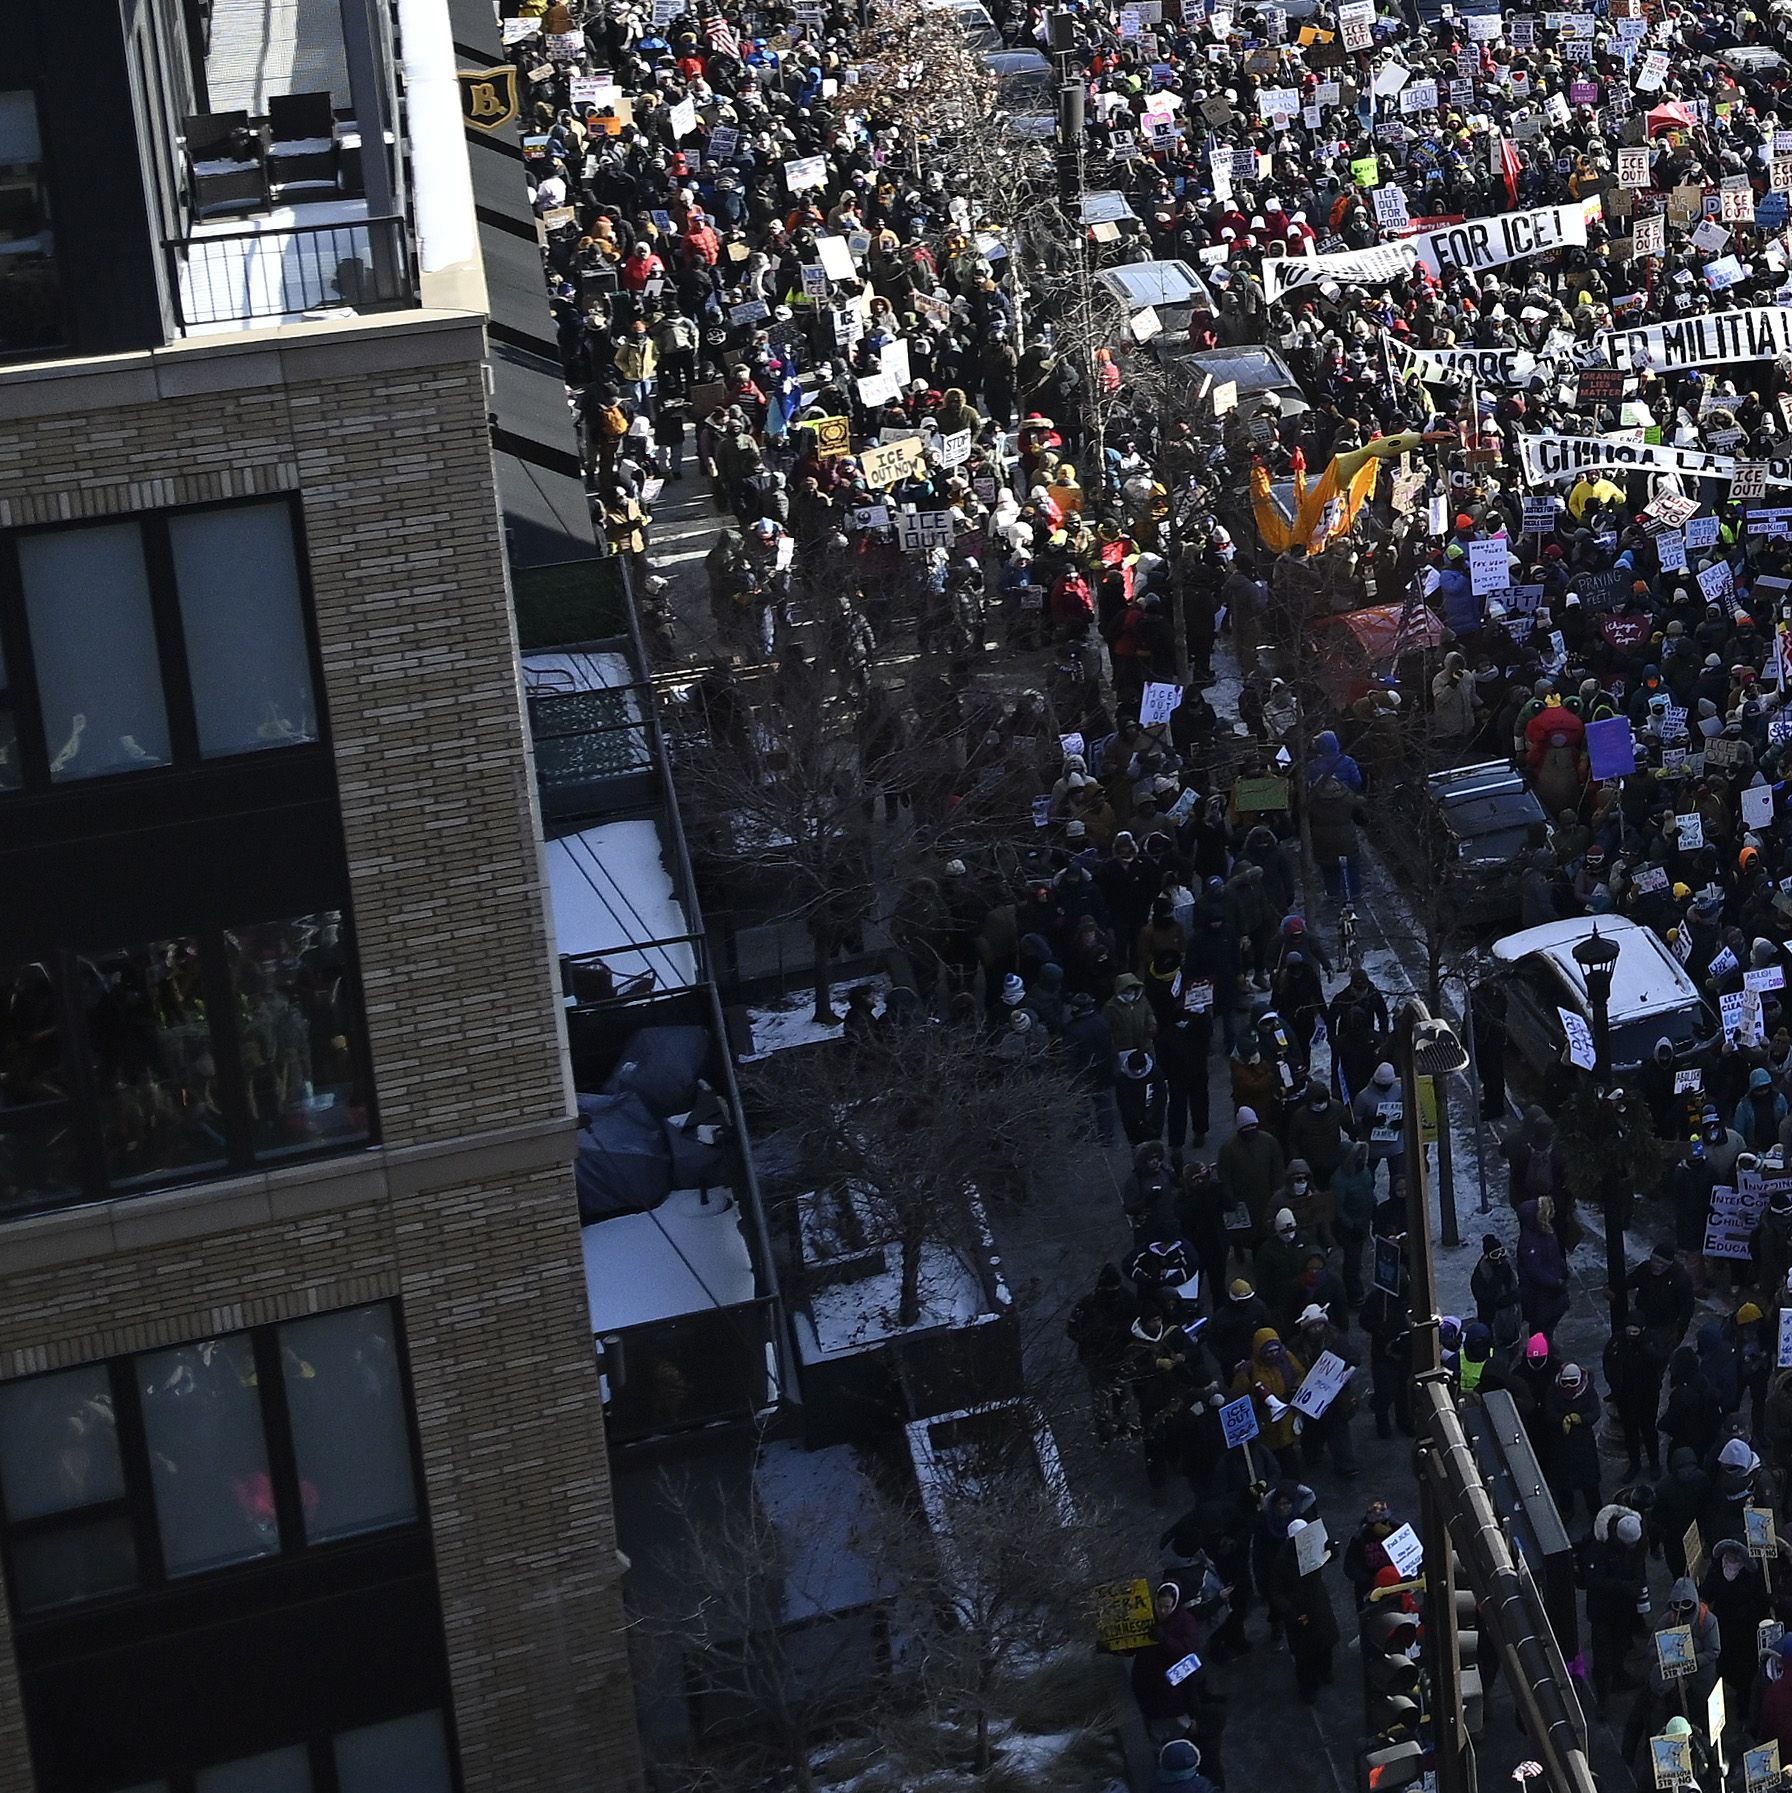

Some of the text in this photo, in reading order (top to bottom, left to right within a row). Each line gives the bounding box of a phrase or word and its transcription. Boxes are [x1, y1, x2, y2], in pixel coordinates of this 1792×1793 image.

[1380, 190, 1397, 199] ICE
[1379, 199, 1399, 209] OUT
[1380, 209, 1400, 219] FOR
[1430, 226, 1489, 270] FOR
[1502, 212, 1562, 256] ICE!
[1665, 309, 1790, 366] MILITIA!
[1582, 372, 1622, 382] ORANGE
[1580, 389, 1620, 397] MATTER
[878, 449, 904, 468] ICE
[870, 458, 919, 484] OUT NOW
[906, 513, 949, 530] ICE
[905, 531, 949, 549] OUT
